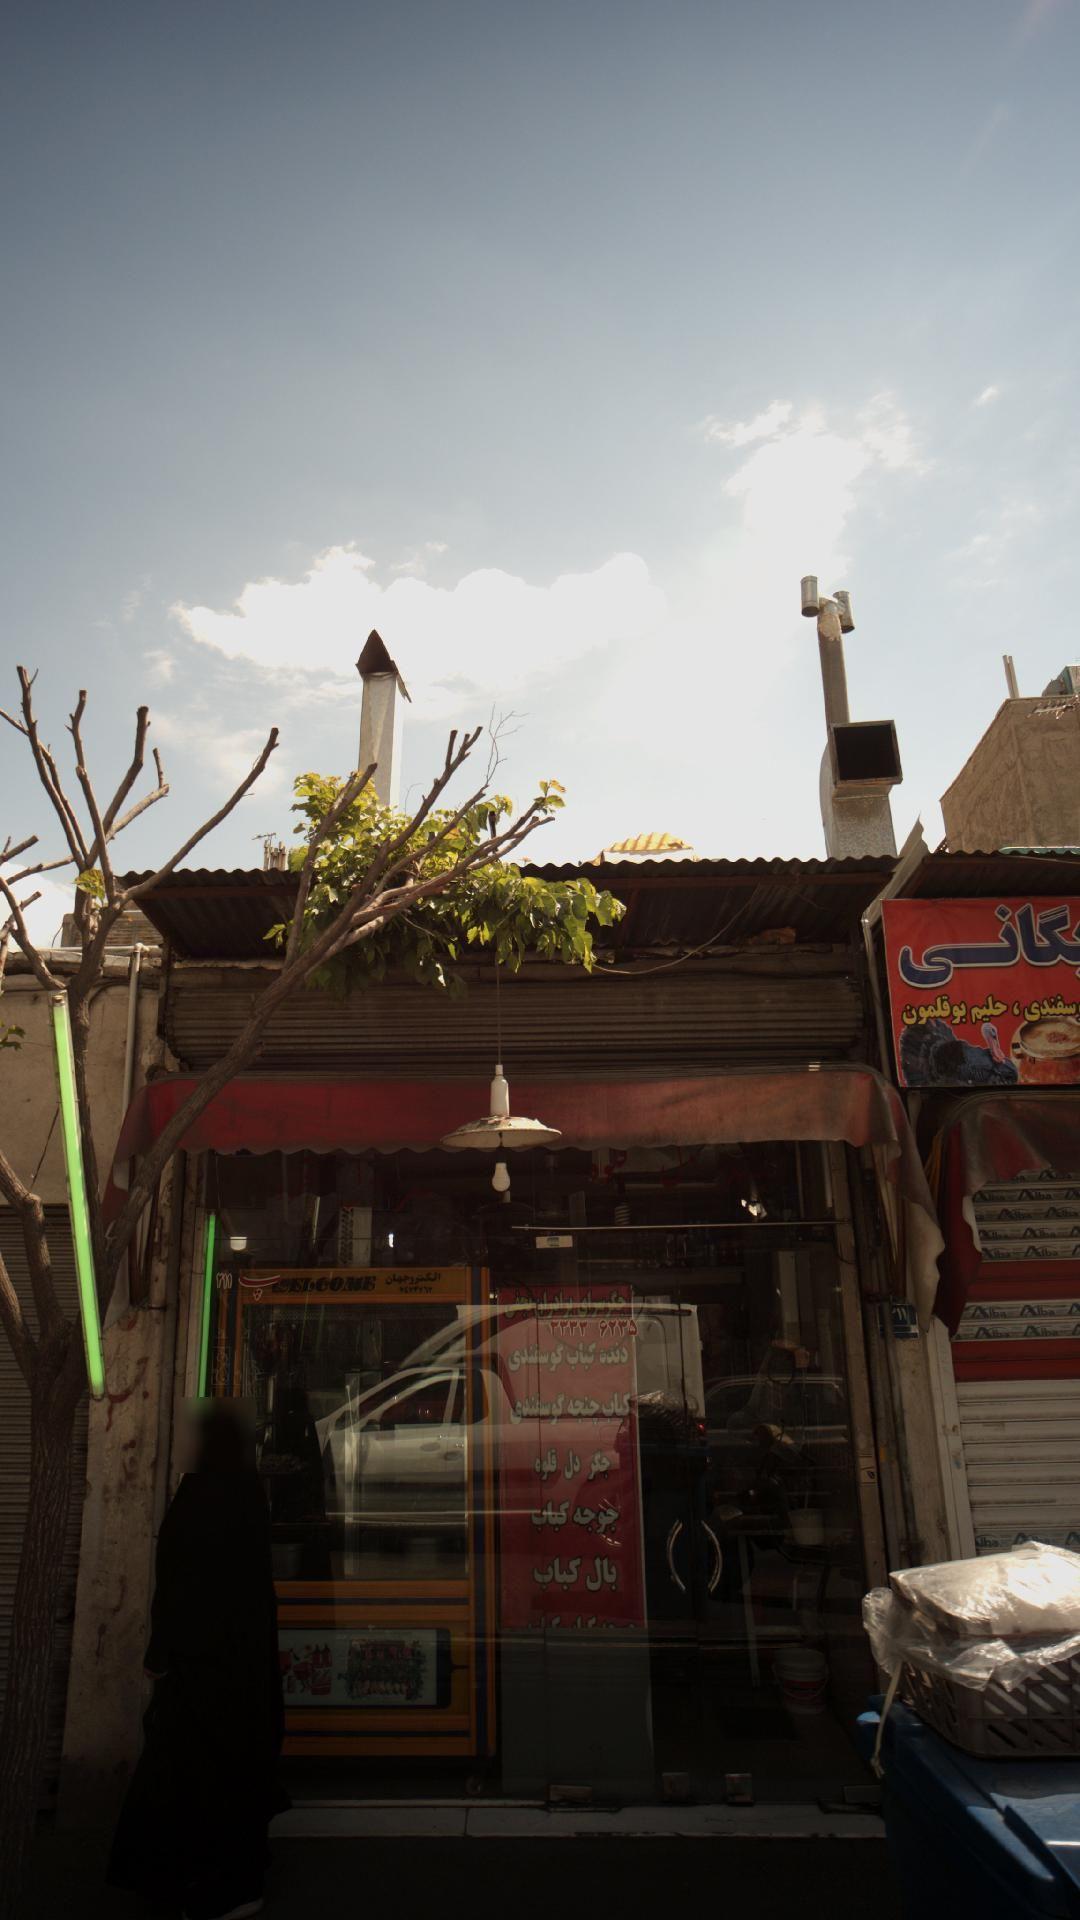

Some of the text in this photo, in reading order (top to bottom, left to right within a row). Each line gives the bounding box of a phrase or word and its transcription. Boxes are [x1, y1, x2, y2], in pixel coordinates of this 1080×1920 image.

[902, 994, 966, 1025] بوقلمون
[970, 994, 1008, 1025] حلیم
[1018, 1189, 1052, 1201] Alba
[1023, 1227, 1056, 1239] Alba
[1024, 1245, 1058, 1257] Alba
[972, 1305, 1007, 1319] Alba
[1020, 1304, 1055, 1316] Alba
[1024, 1325, 1059, 1337] Alba
[566, 1342, 597, 1371] کباب
[602, 1392, 632, 1423] کباب
[534, 1449, 558, 1480] قلوه
[564, 1449, 580, 1480] دل
[531, 1499, 619, 1533] جوجه کباب
[532, 1555, 618, 1592] بال کباب
